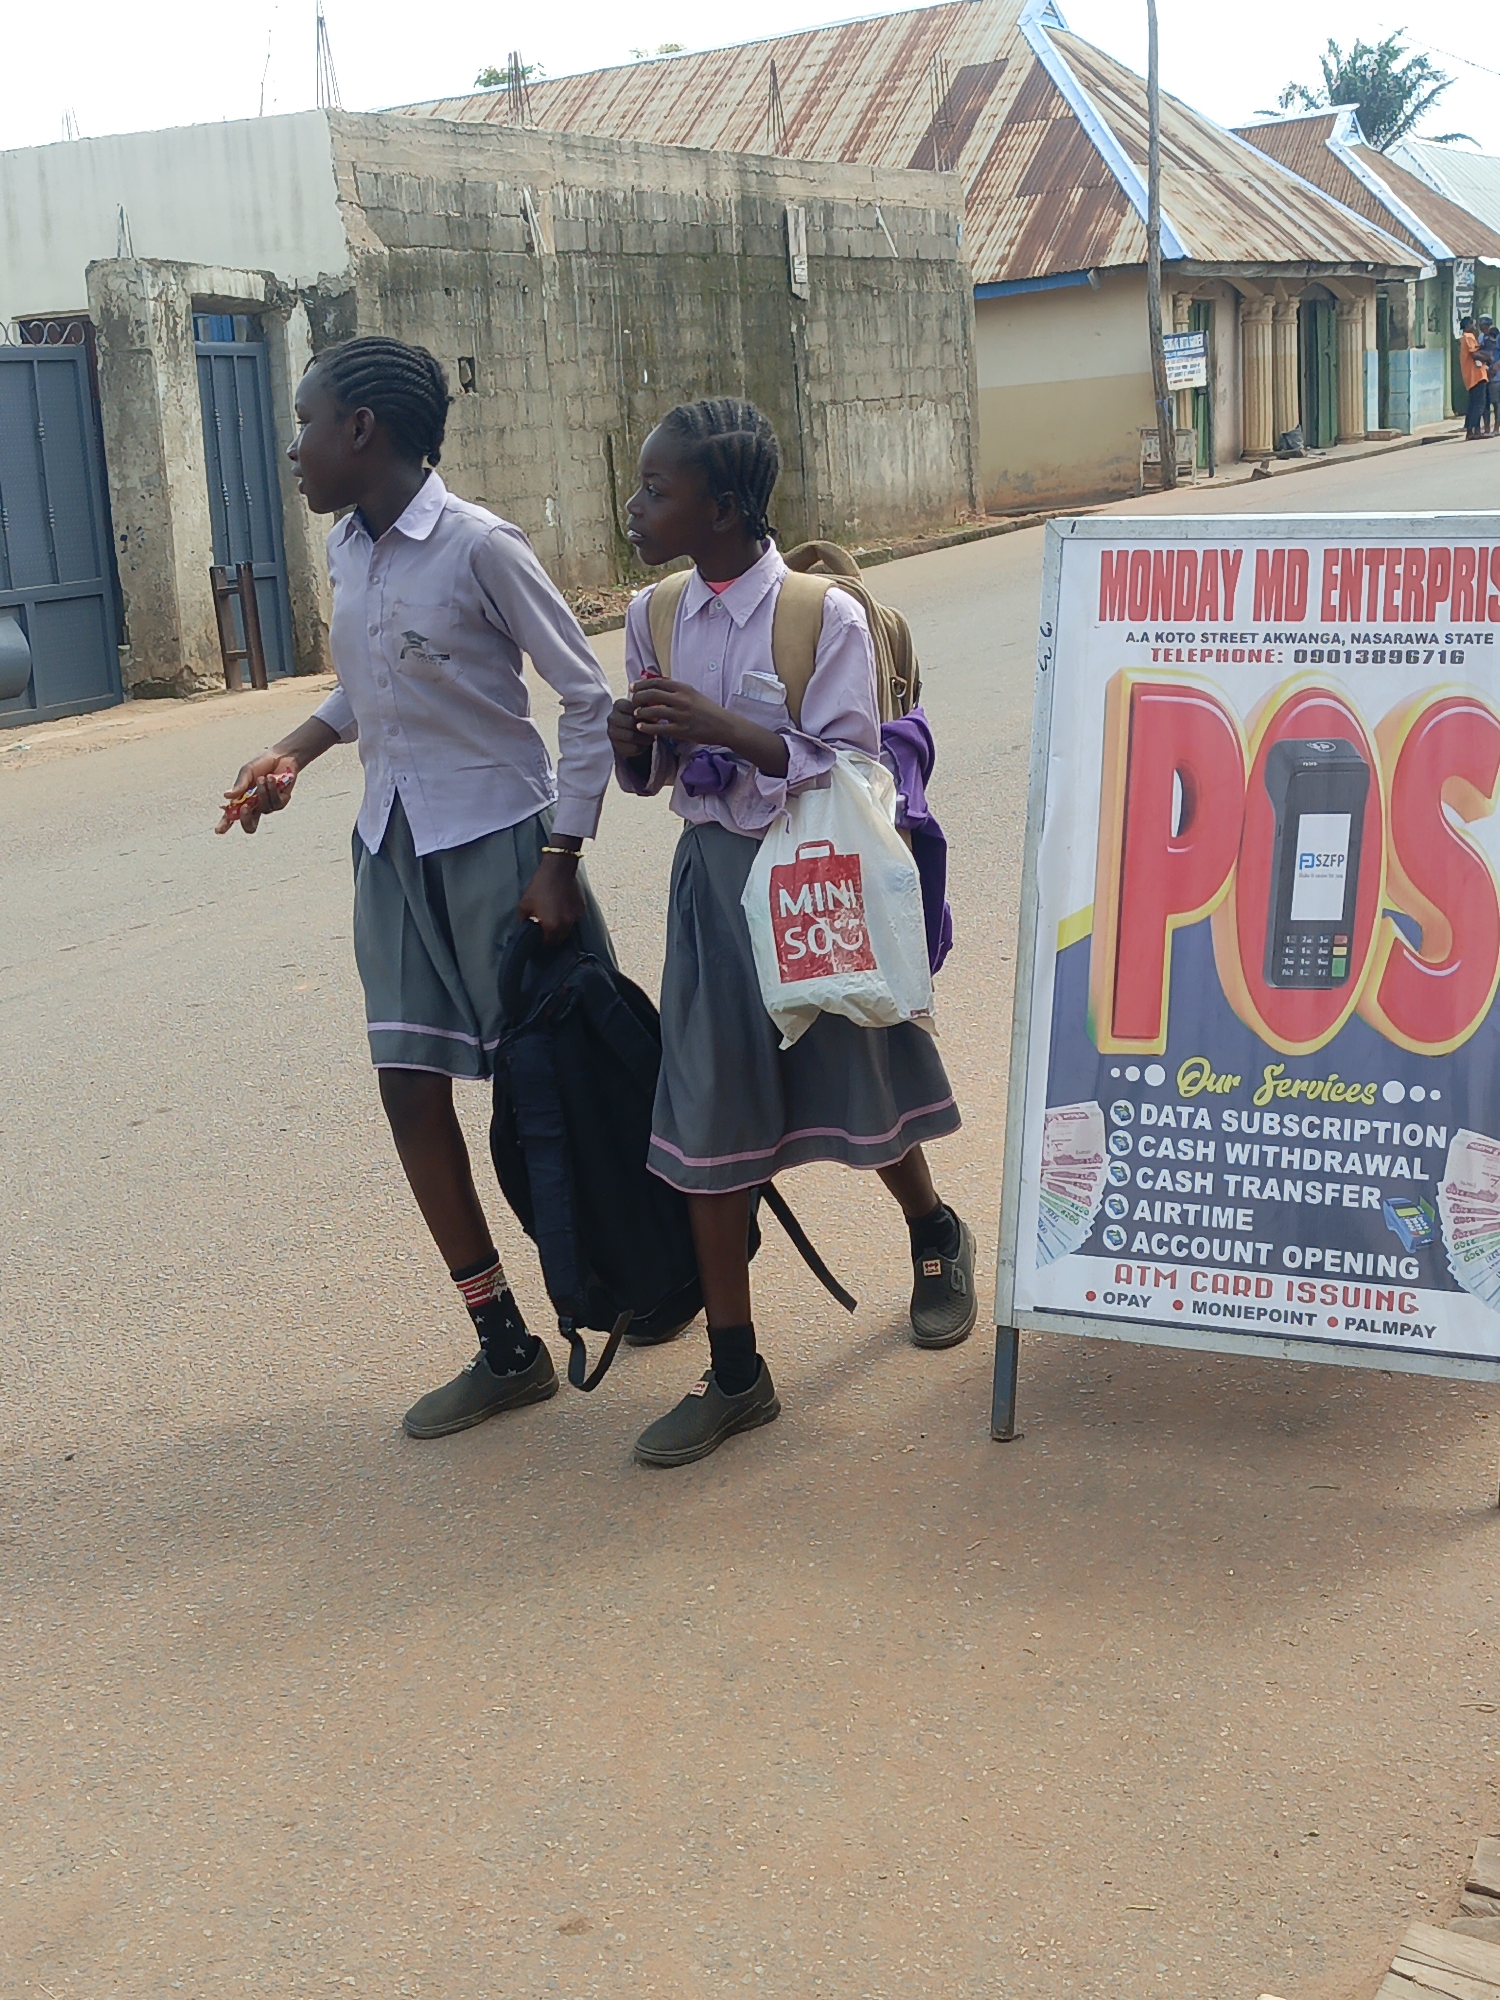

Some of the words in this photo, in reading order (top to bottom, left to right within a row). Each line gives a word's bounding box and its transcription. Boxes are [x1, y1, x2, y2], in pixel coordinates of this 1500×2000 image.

[1099, 549, 1243, 622] MONDAY
[1253, 548, 1309, 622] MD
[1126, 632, 1150, 643] A.A
[1155, 632, 1195, 643] KOTO
[1200, 632, 1259, 644] STREET
[1262, 632, 1346, 646] AKWANGA,
[1350, 633, 1439, 645] NASARAWA
[1444, 633, 1494, 645] STATE
[1151, 648, 1283, 663] TELEPHONE:
[1294, 649, 1465, 664] 09013896716
[1095, 667, 1500, 1056] POS
[778, 879, 857, 918] MINI
[1176, 1056, 1241, 1098] Our
[1253, 1064, 1378, 1107] Services
[1140, 1103, 1212, 1131] DATA
[1221, 1109, 1447, 1149] SUBSCRIPTION
[1138, 1136, 1216, 1163] CASH
[1225, 1142, 1430, 1181] WITHDRAWAL
[1136, 1167, 1213, 1195] CASH
[1223, 1174, 1381, 1210] TRANSFER
[1133, 1199, 1254, 1231] AIRTIME
[1131, 1231, 1273, 1265] ACCOUNT
[1283, 1245, 1420, 1280] OPENING
[1114, 1263, 1177, 1290] ATM
[1191, 1271, 1273, 1299] CARD
[1287, 1281, 1419, 1314] ISSUING
[1102, 1291, 1152, 1308] OPAY
[1192, 1300, 1318, 1327] MONIEPOINT
[1344, 1317, 1437, 1339] PALMPAY
